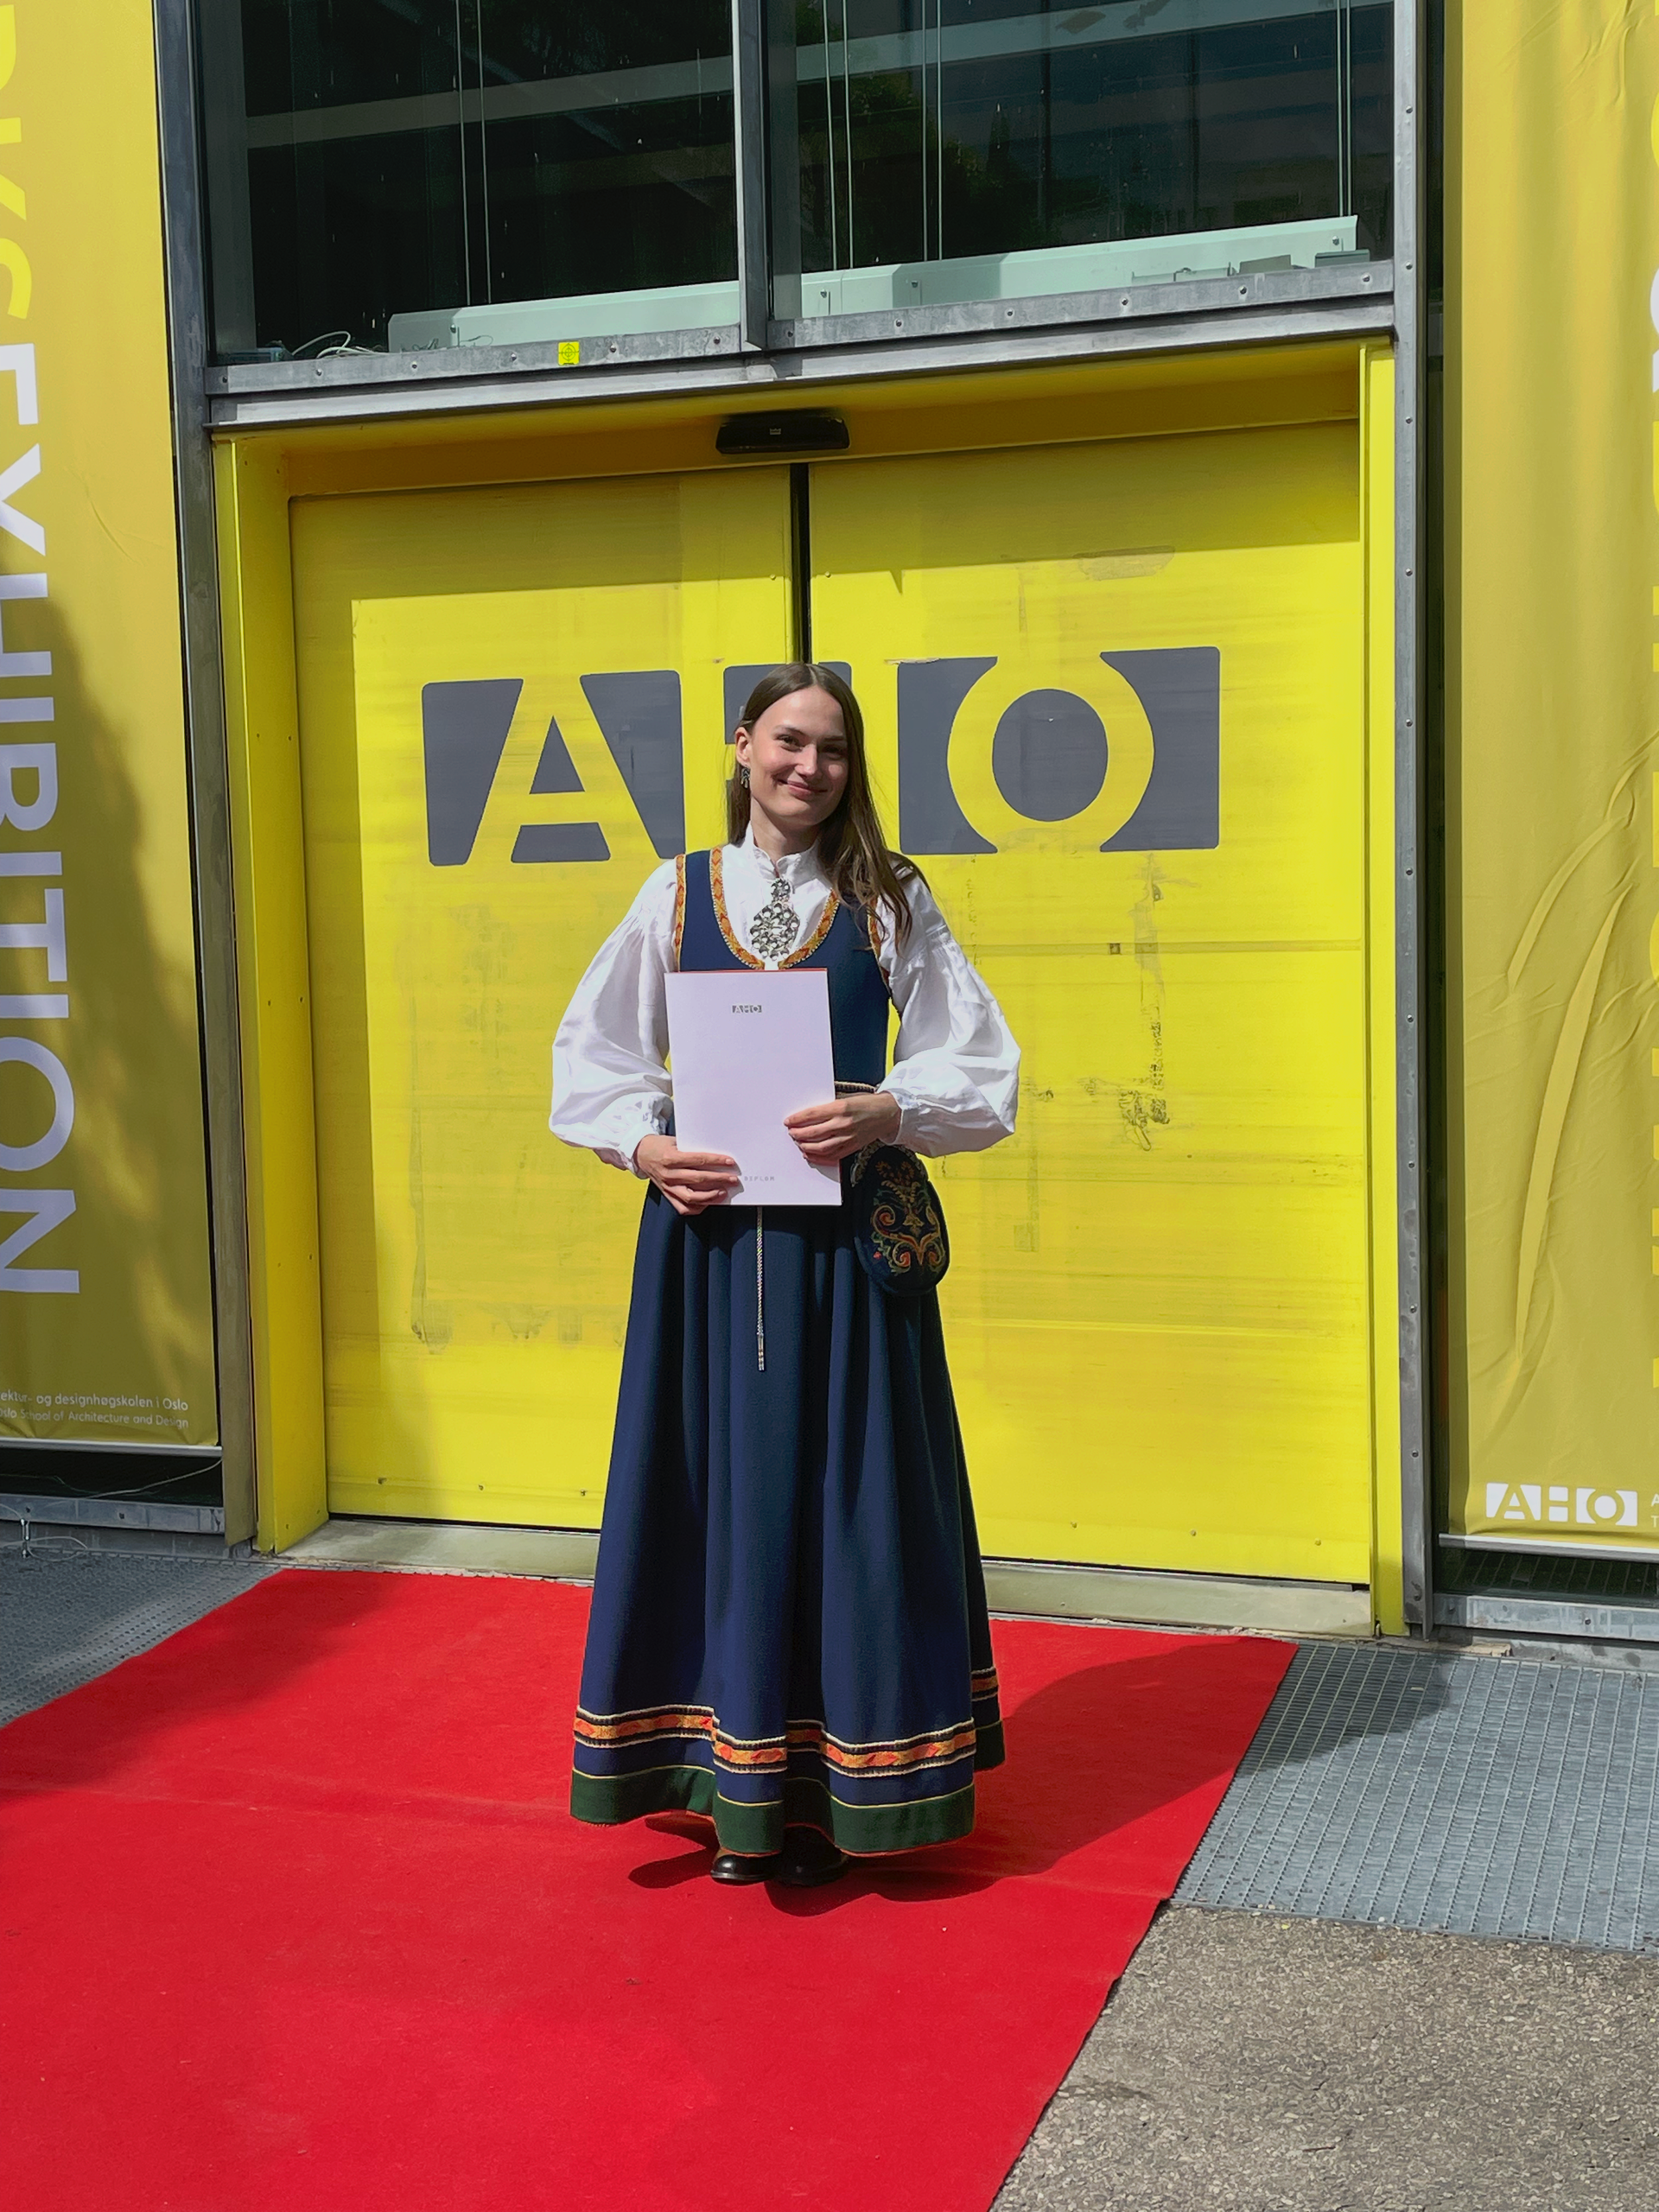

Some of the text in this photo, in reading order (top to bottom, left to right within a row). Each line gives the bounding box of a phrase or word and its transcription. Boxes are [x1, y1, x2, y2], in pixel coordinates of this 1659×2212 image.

[732, 1005, 762, 1014] AHO
[36, 1395, 52, 1407] og
[54, 1392, 153, 1408] designhøgskolen
[162, 1397, 188, 1411] Oslo
[54, 1410, 64, 1421] of
[68, 1410, 130, 1424] Architecture
[132, 1414, 152, 1426] and
[156, 1414, 188, 1430] Design
[1486, 1482, 1637, 1527] AHO
